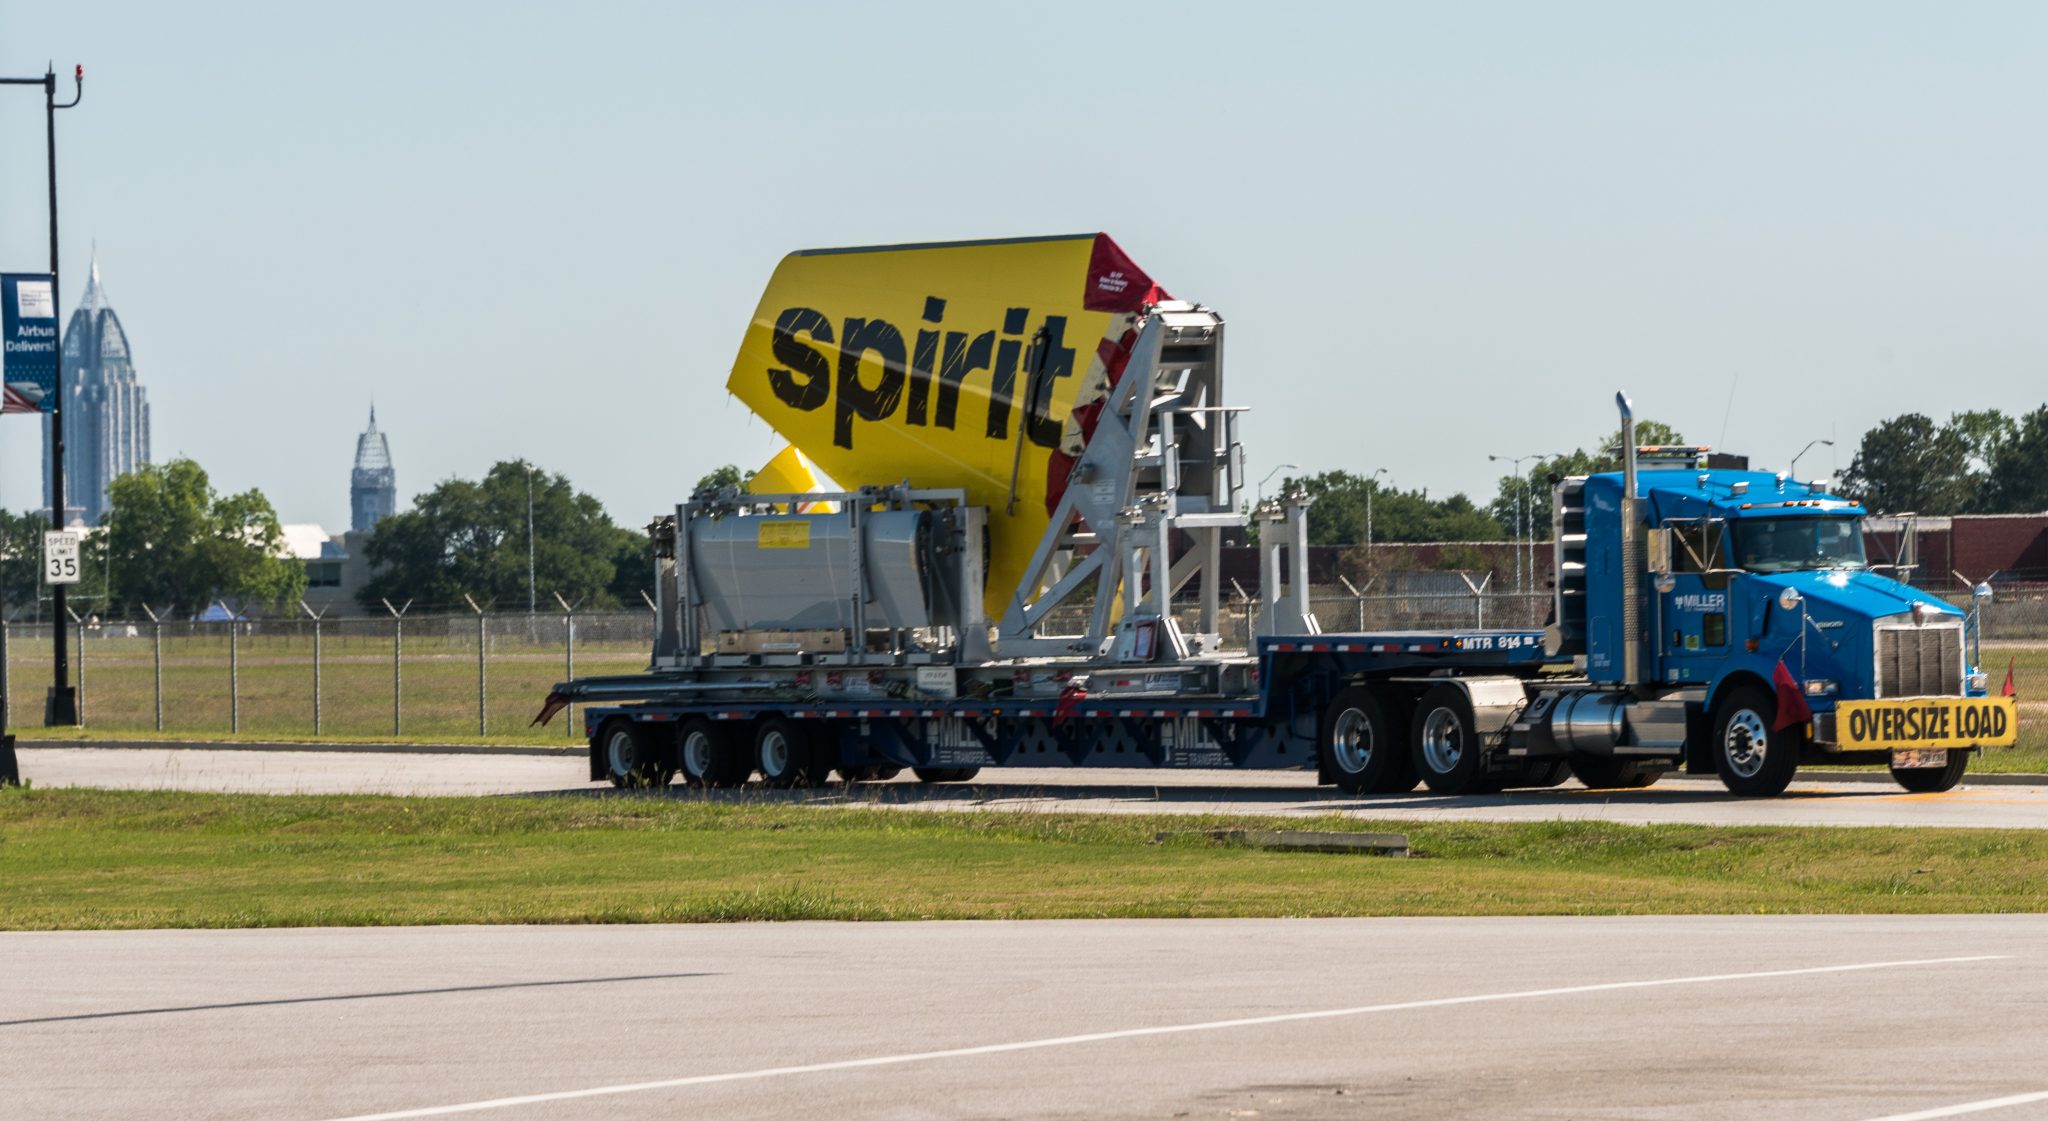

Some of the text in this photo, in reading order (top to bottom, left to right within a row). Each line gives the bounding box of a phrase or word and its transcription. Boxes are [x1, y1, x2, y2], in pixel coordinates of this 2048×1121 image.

[17, 325, 56, 336] Airbus
[5, 341, 56, 352] Delivers!
[767, 296, 1076, 450] spirit
[49, 537, 76, 545] SPEED
[51, 548, 73, 556] LIMIT
[50, 558, 76, 576] 35
[1684, 594, 1725, 607] MILLER
[1463, 636, 1520, 649] MTR 814
[1850, 705, 2007, 741] OVERSIZE LOAD
